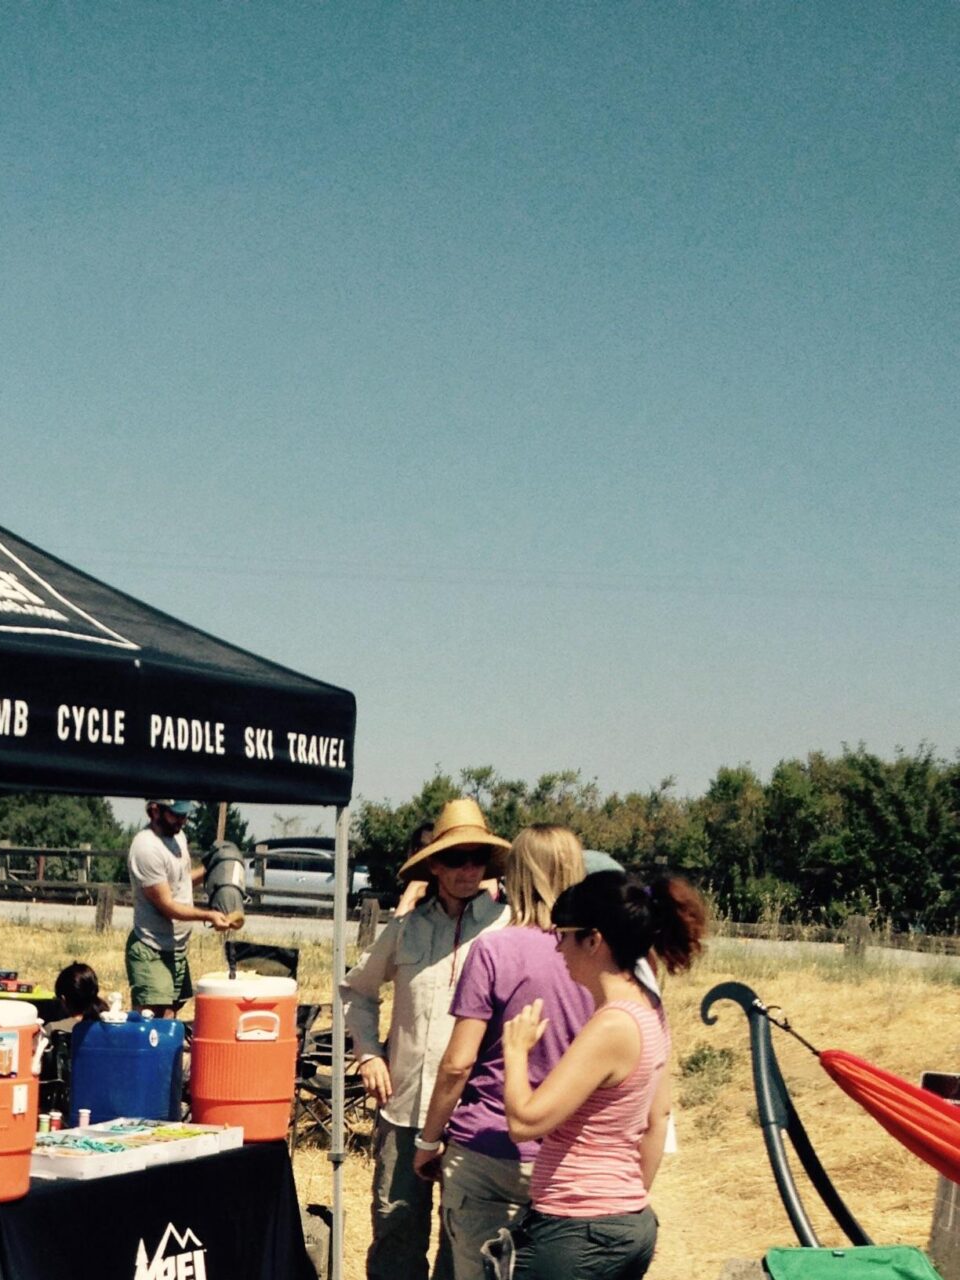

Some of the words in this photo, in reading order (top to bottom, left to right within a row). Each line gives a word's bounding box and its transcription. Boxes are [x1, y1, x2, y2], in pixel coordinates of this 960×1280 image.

[57, 704, 126, 745] CYCLE
[150, 715, 226, 755] PADDLE
[244, 726, 274, 760] SKI
[287, 732, 346, 769] TRAVEL
